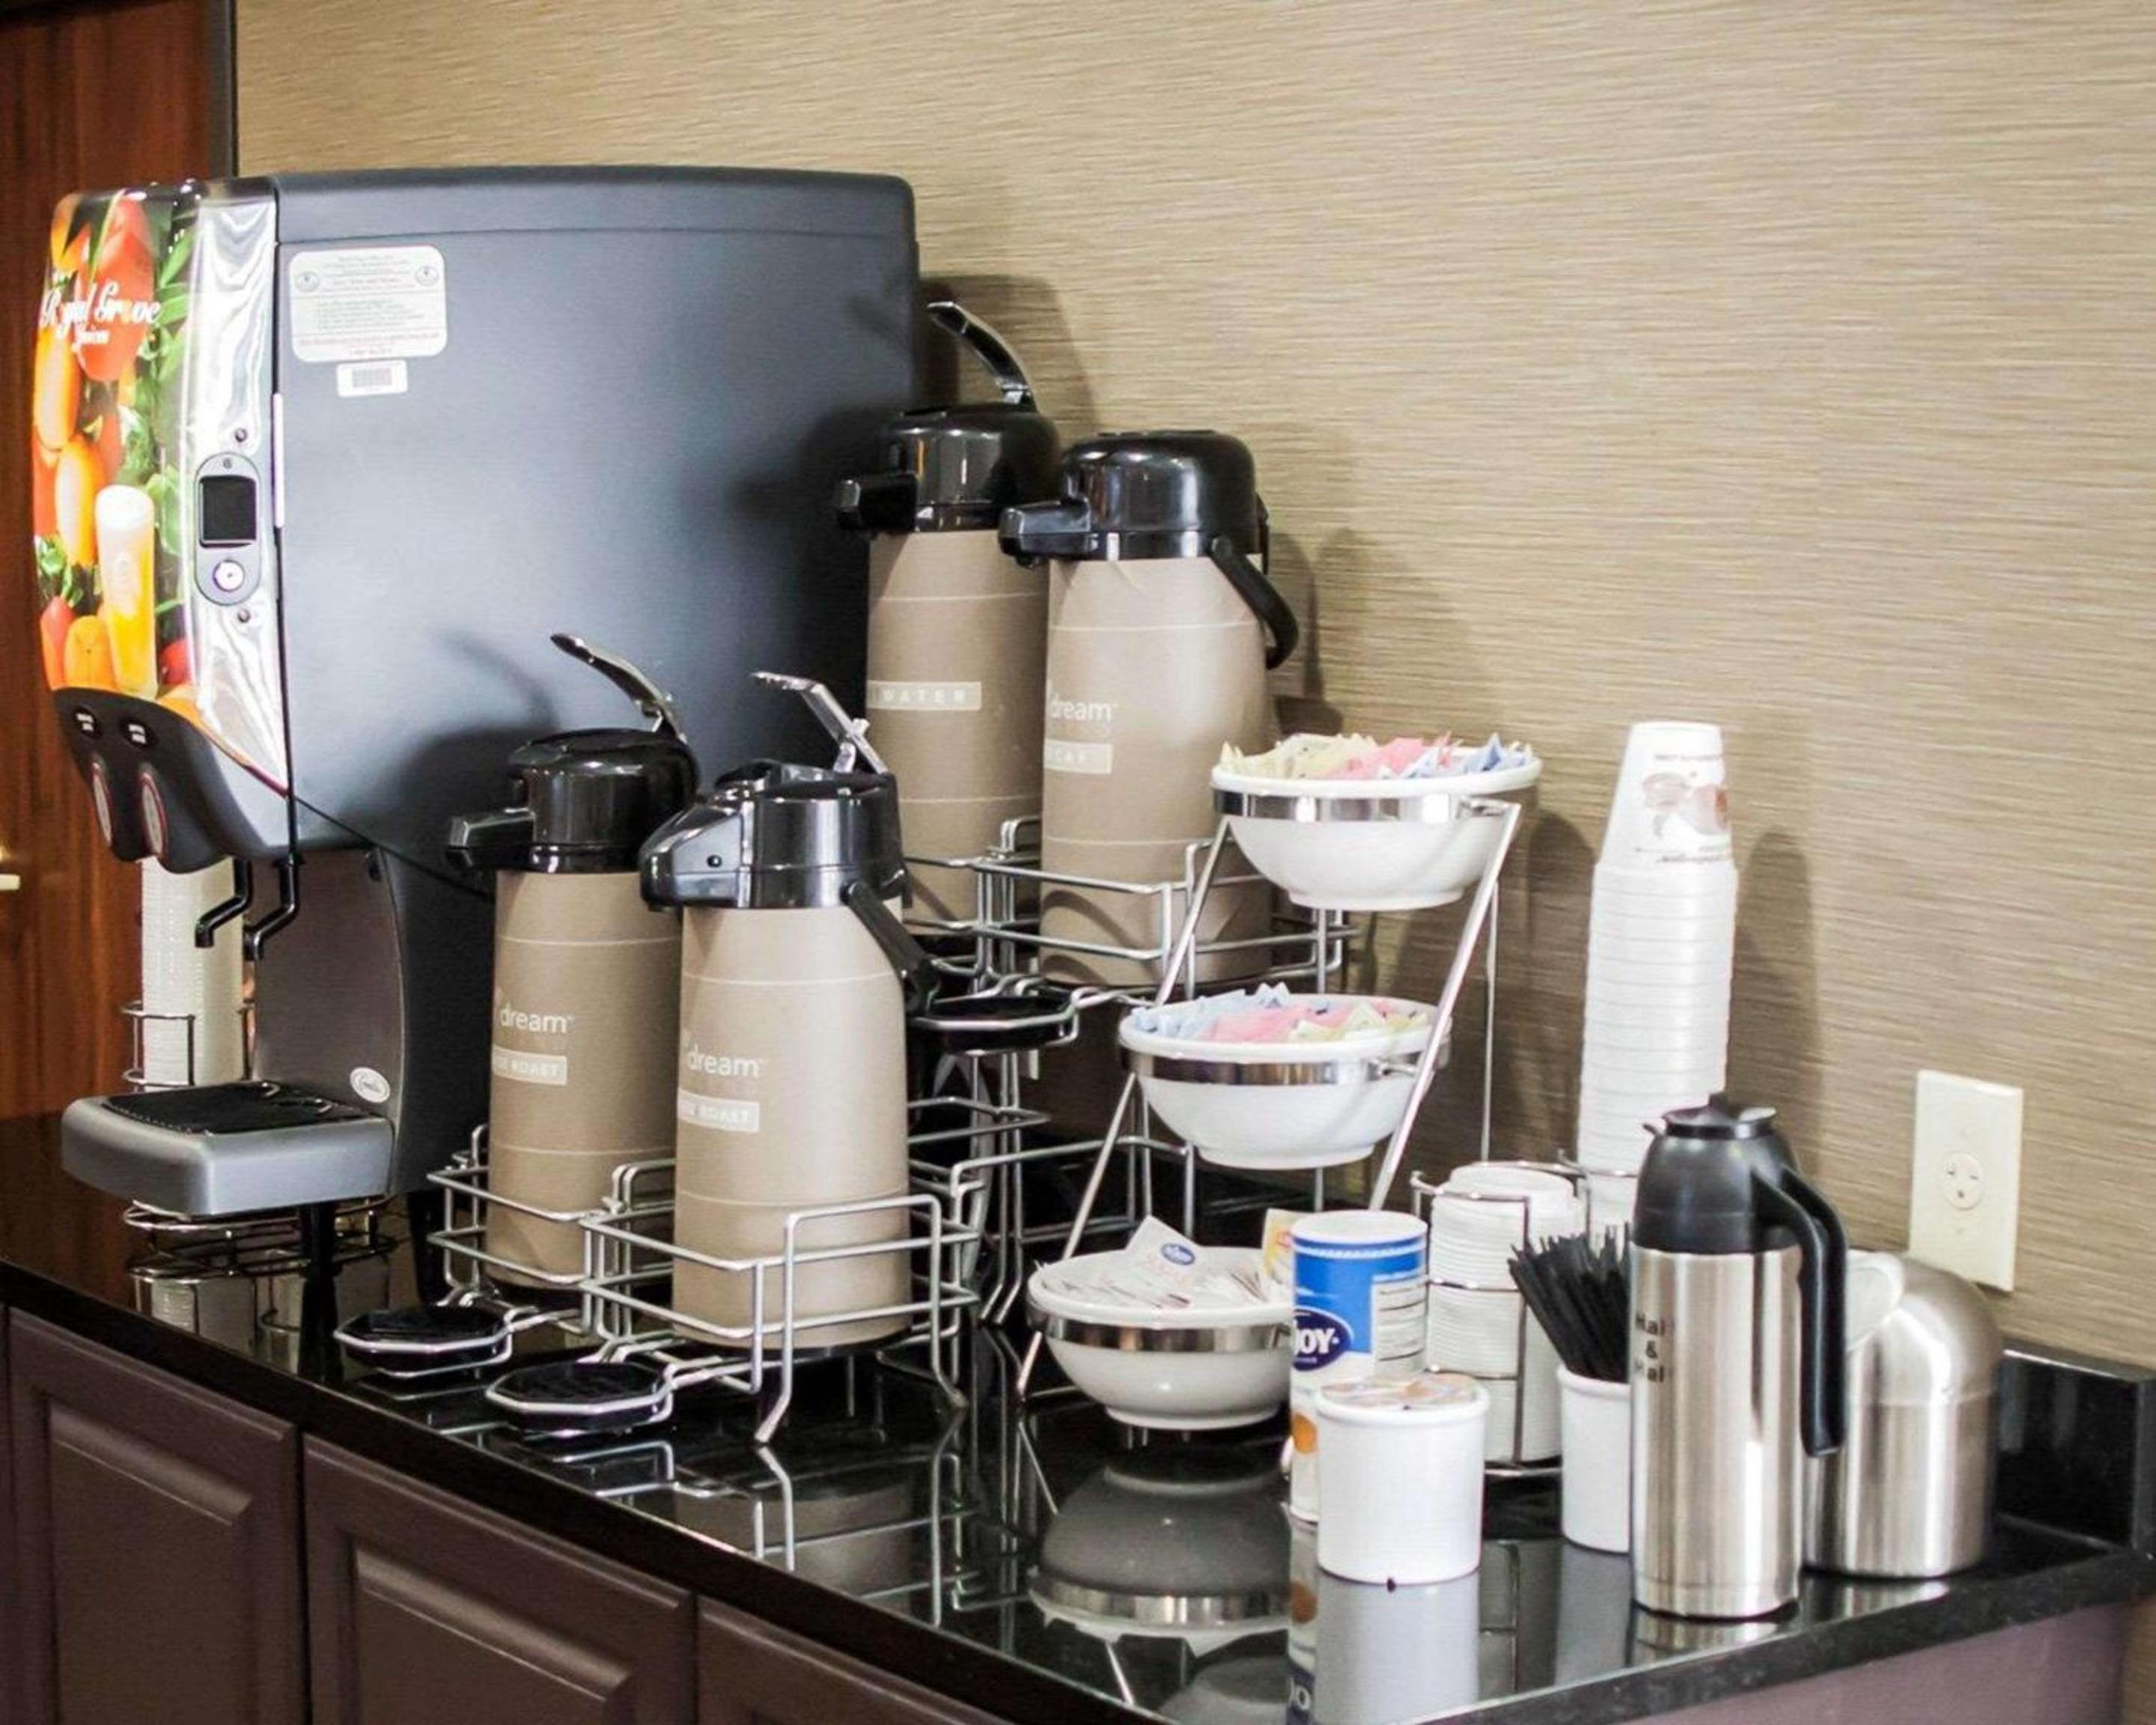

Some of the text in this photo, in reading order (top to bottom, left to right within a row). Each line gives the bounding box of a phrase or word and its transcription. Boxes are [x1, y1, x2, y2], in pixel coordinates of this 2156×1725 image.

[883, 688, 966, 705] WATER
[1050, 692, 1113, 722] dream
[499, 1002, 567, 1034] dream
[686, 1043, 760, 1079] dream
[1645, 1340, 1658, 1360] &
